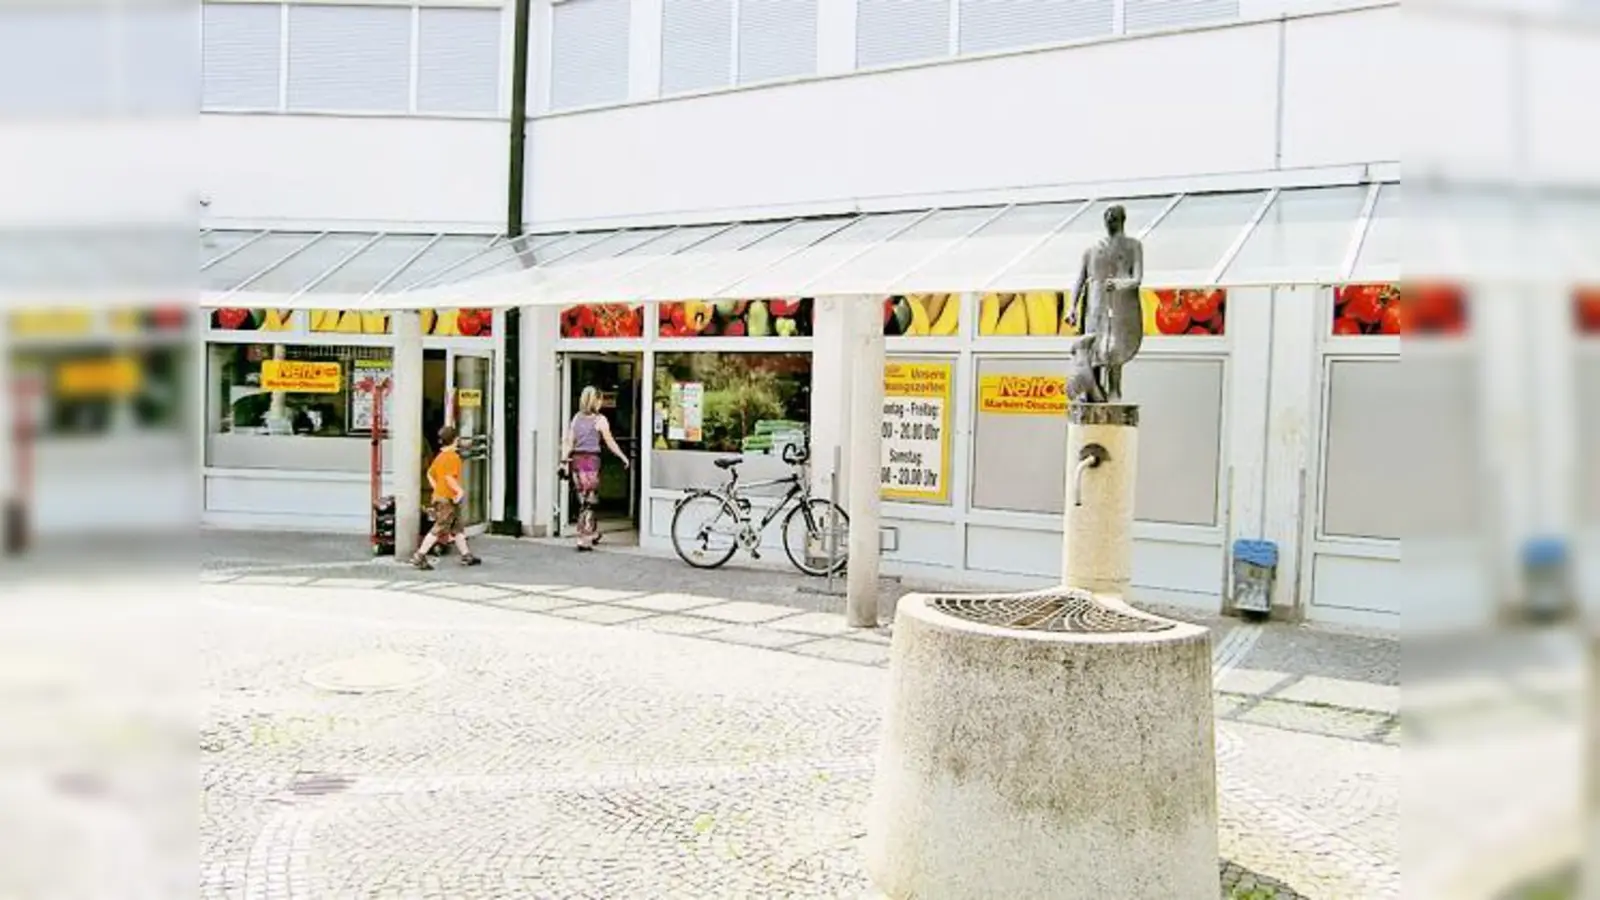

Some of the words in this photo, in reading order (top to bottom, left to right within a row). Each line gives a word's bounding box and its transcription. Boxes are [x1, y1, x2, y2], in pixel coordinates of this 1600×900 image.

[910, 368, 946, 380] Unsere
[997, 376, 1061, 398] Netto
[924, 423, 940, 440] Uhr
